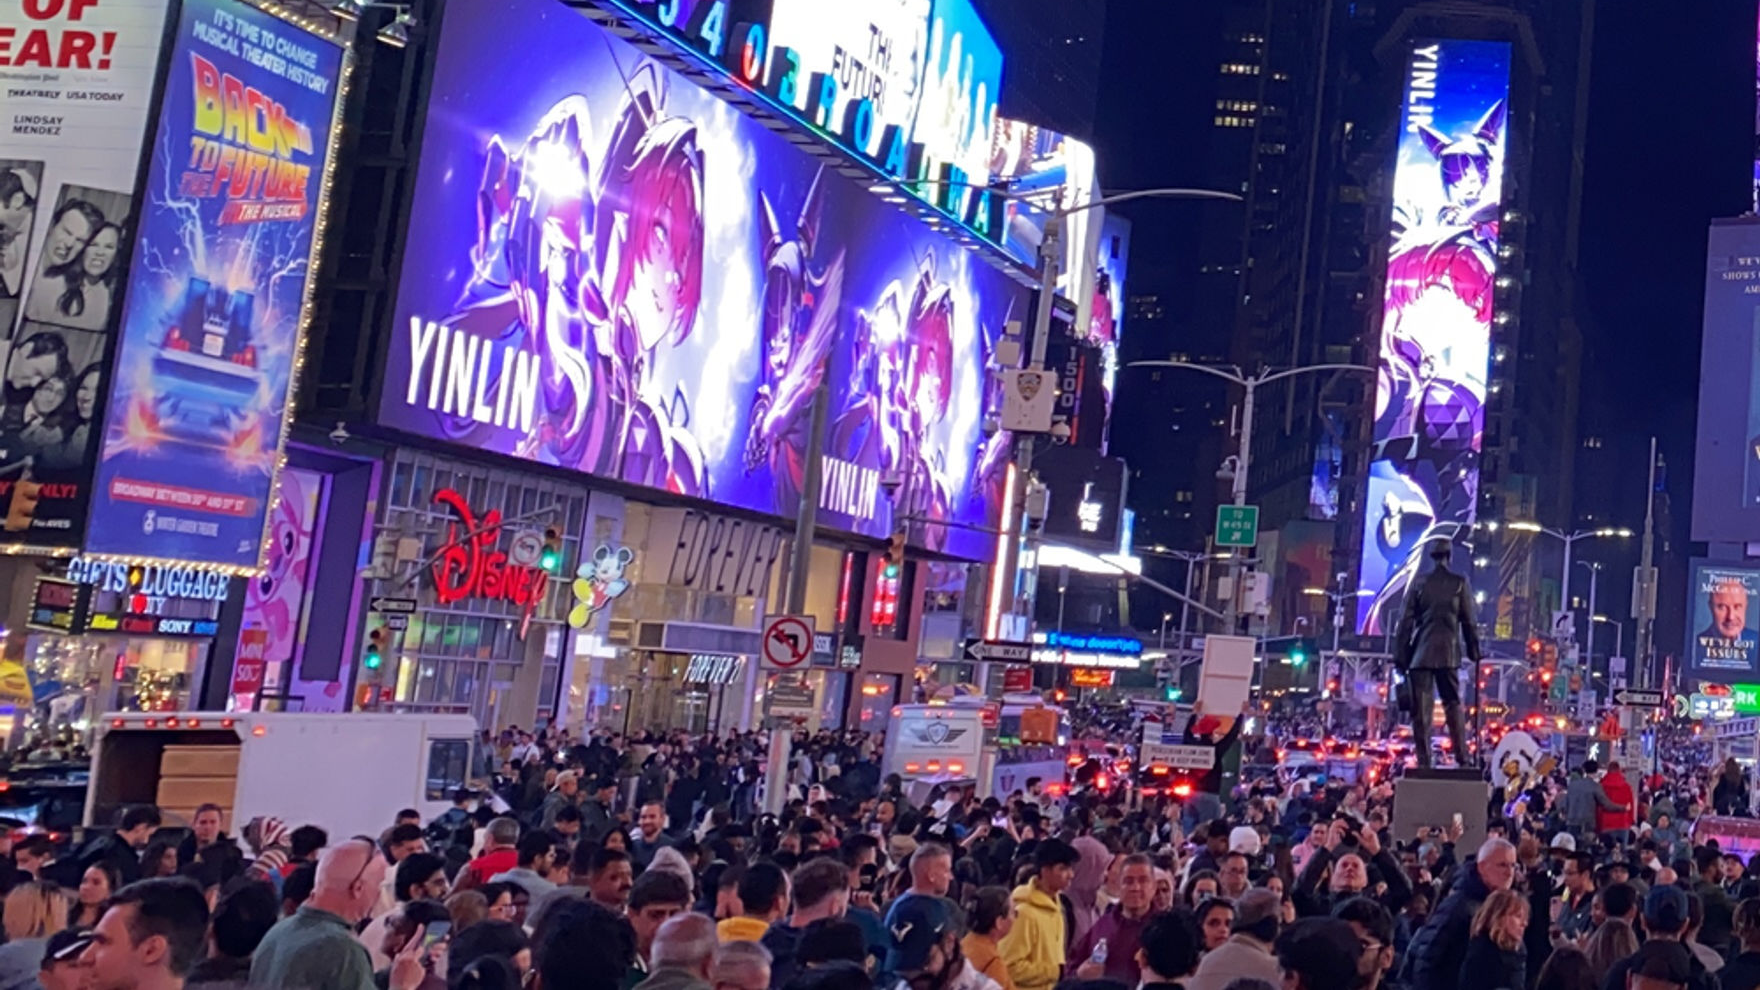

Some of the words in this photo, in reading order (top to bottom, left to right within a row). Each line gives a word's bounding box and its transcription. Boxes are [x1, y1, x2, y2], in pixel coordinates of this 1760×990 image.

[0, 28, 118, 70] EAR!
[192, 20, 240, 57] MUSICAL
[242, 41, 287, 76] THEATER
[287, 63, 330, 95] HISTORY
[236, 17, 259, 44] TIME
[261, 28, 275, 49] TO
[276, 36, 318, 70] CHANGE
[14, 115, 64, 125] LINDSAY
[89, 92, 124, 102] TODAY
[190, 51, 313, 158] BACK
[13, 125, 61, 136] MENDEZ
[211, 148, 310, 201] FUTURE
[407, 315, 542, 434] YINLIN
[1062, 346, 1077, 408] 1500
[818, 455, 879, 520] YINLIN
[66, 557, 129, 592] GIFTS
[142, 566, 232, 601] LUGGAGE
[668, 510, 784, 598] FOREVER
[159, 619, 194, 634] SONY
[1003, 645, 1025, 657] WAY
